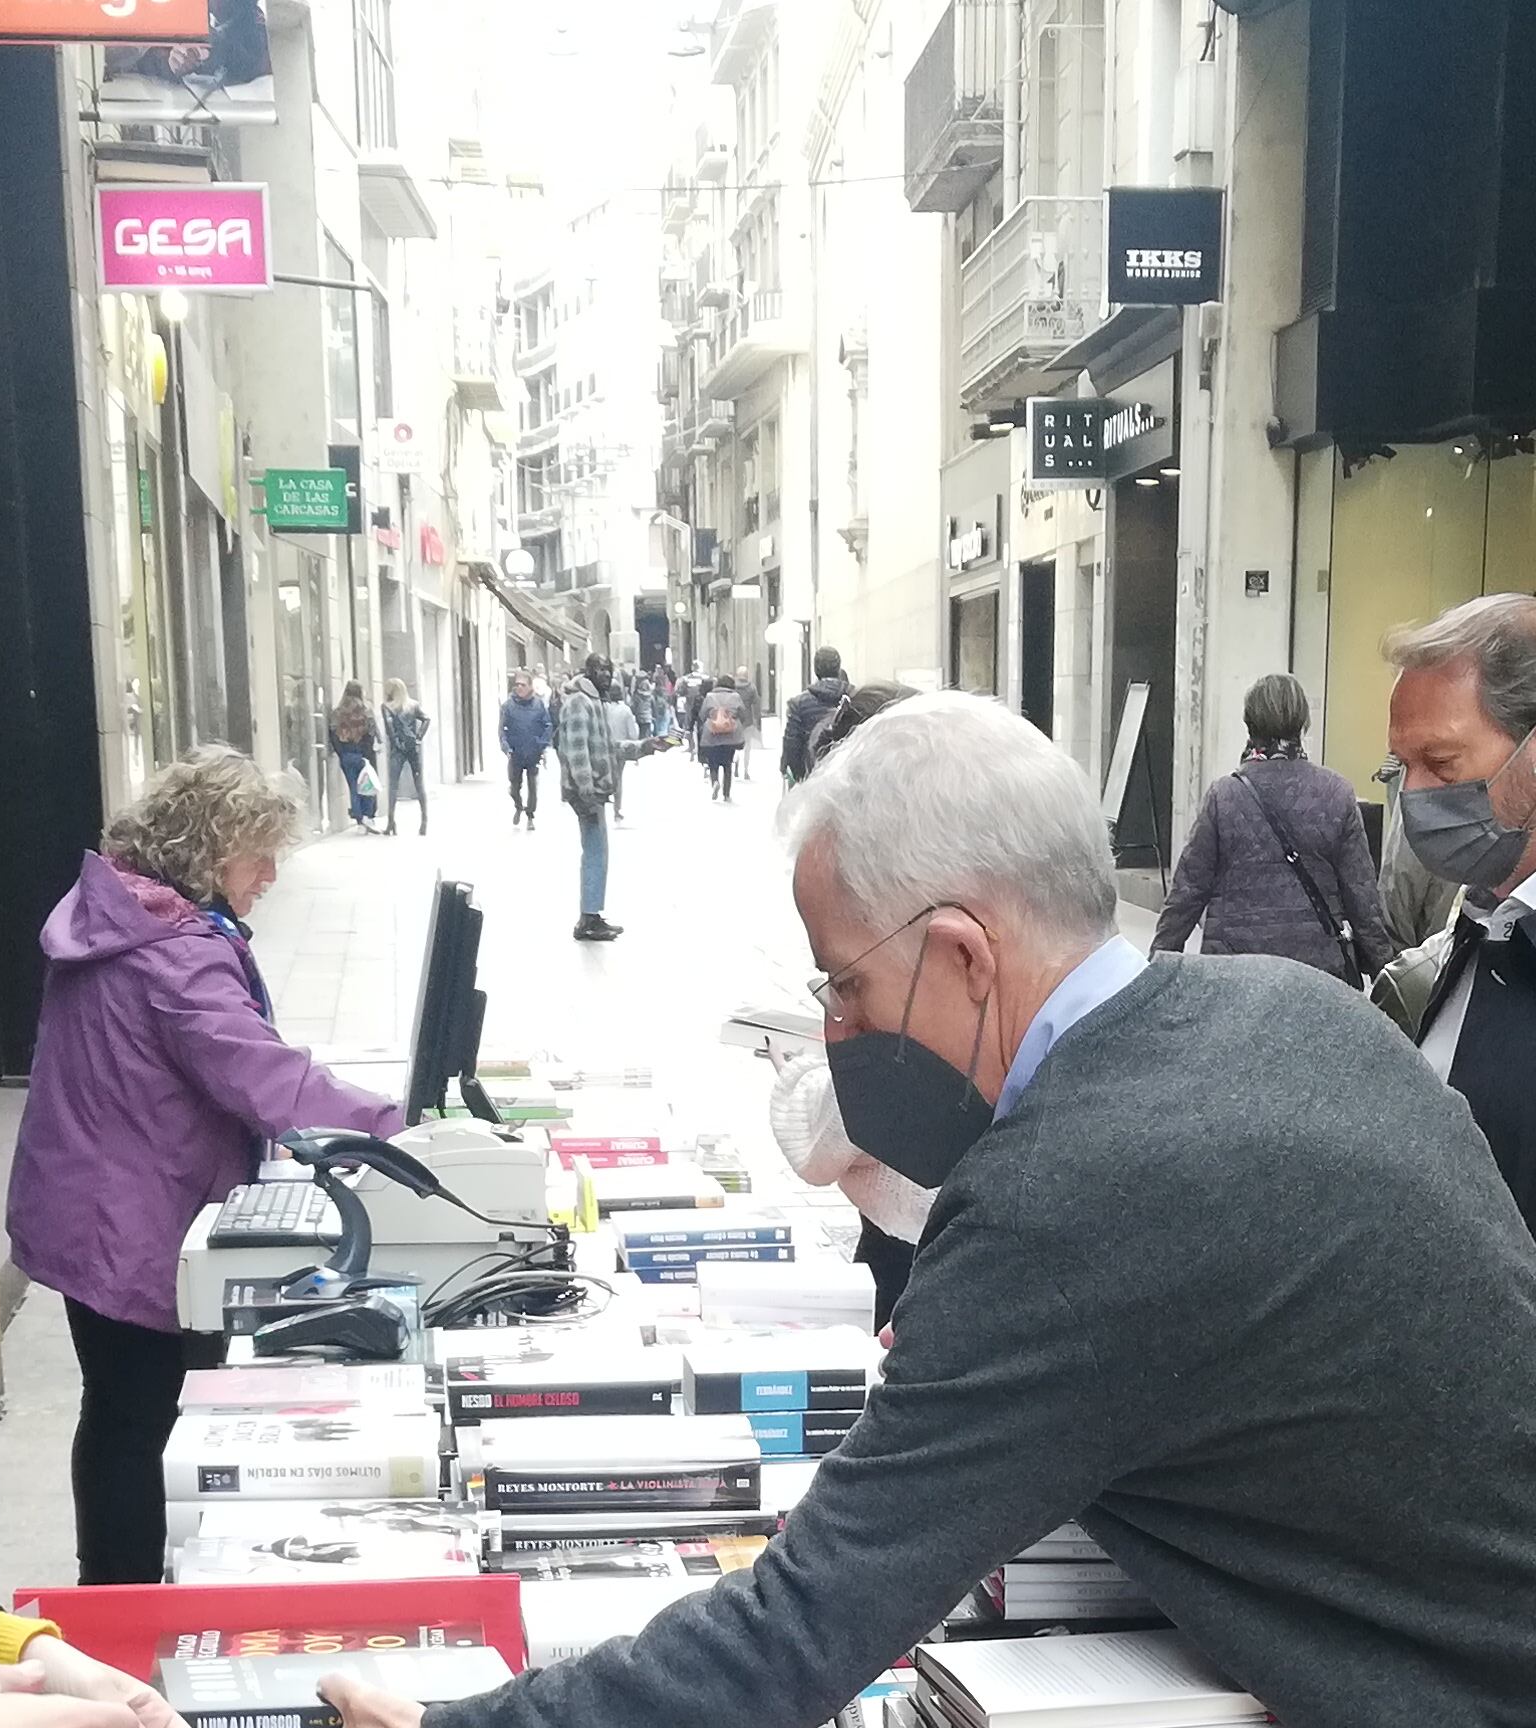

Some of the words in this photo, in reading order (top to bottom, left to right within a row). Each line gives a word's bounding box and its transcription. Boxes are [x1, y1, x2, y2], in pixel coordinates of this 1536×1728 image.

[114, 218, 252, 257] GESA
[1126, 249, 1202, 268] IKKS
[278, 479, 296, 491] LA
[300, 479, 333, 491] CASA
[283, 492, 301, 503] DE
[304, 492, 328, 503] LAS
[274, 504, 338, 516] CARCASAS
[497, 1482, 537, 1494] REYES
[539, 1481, 604, 1493] MONFORTE
